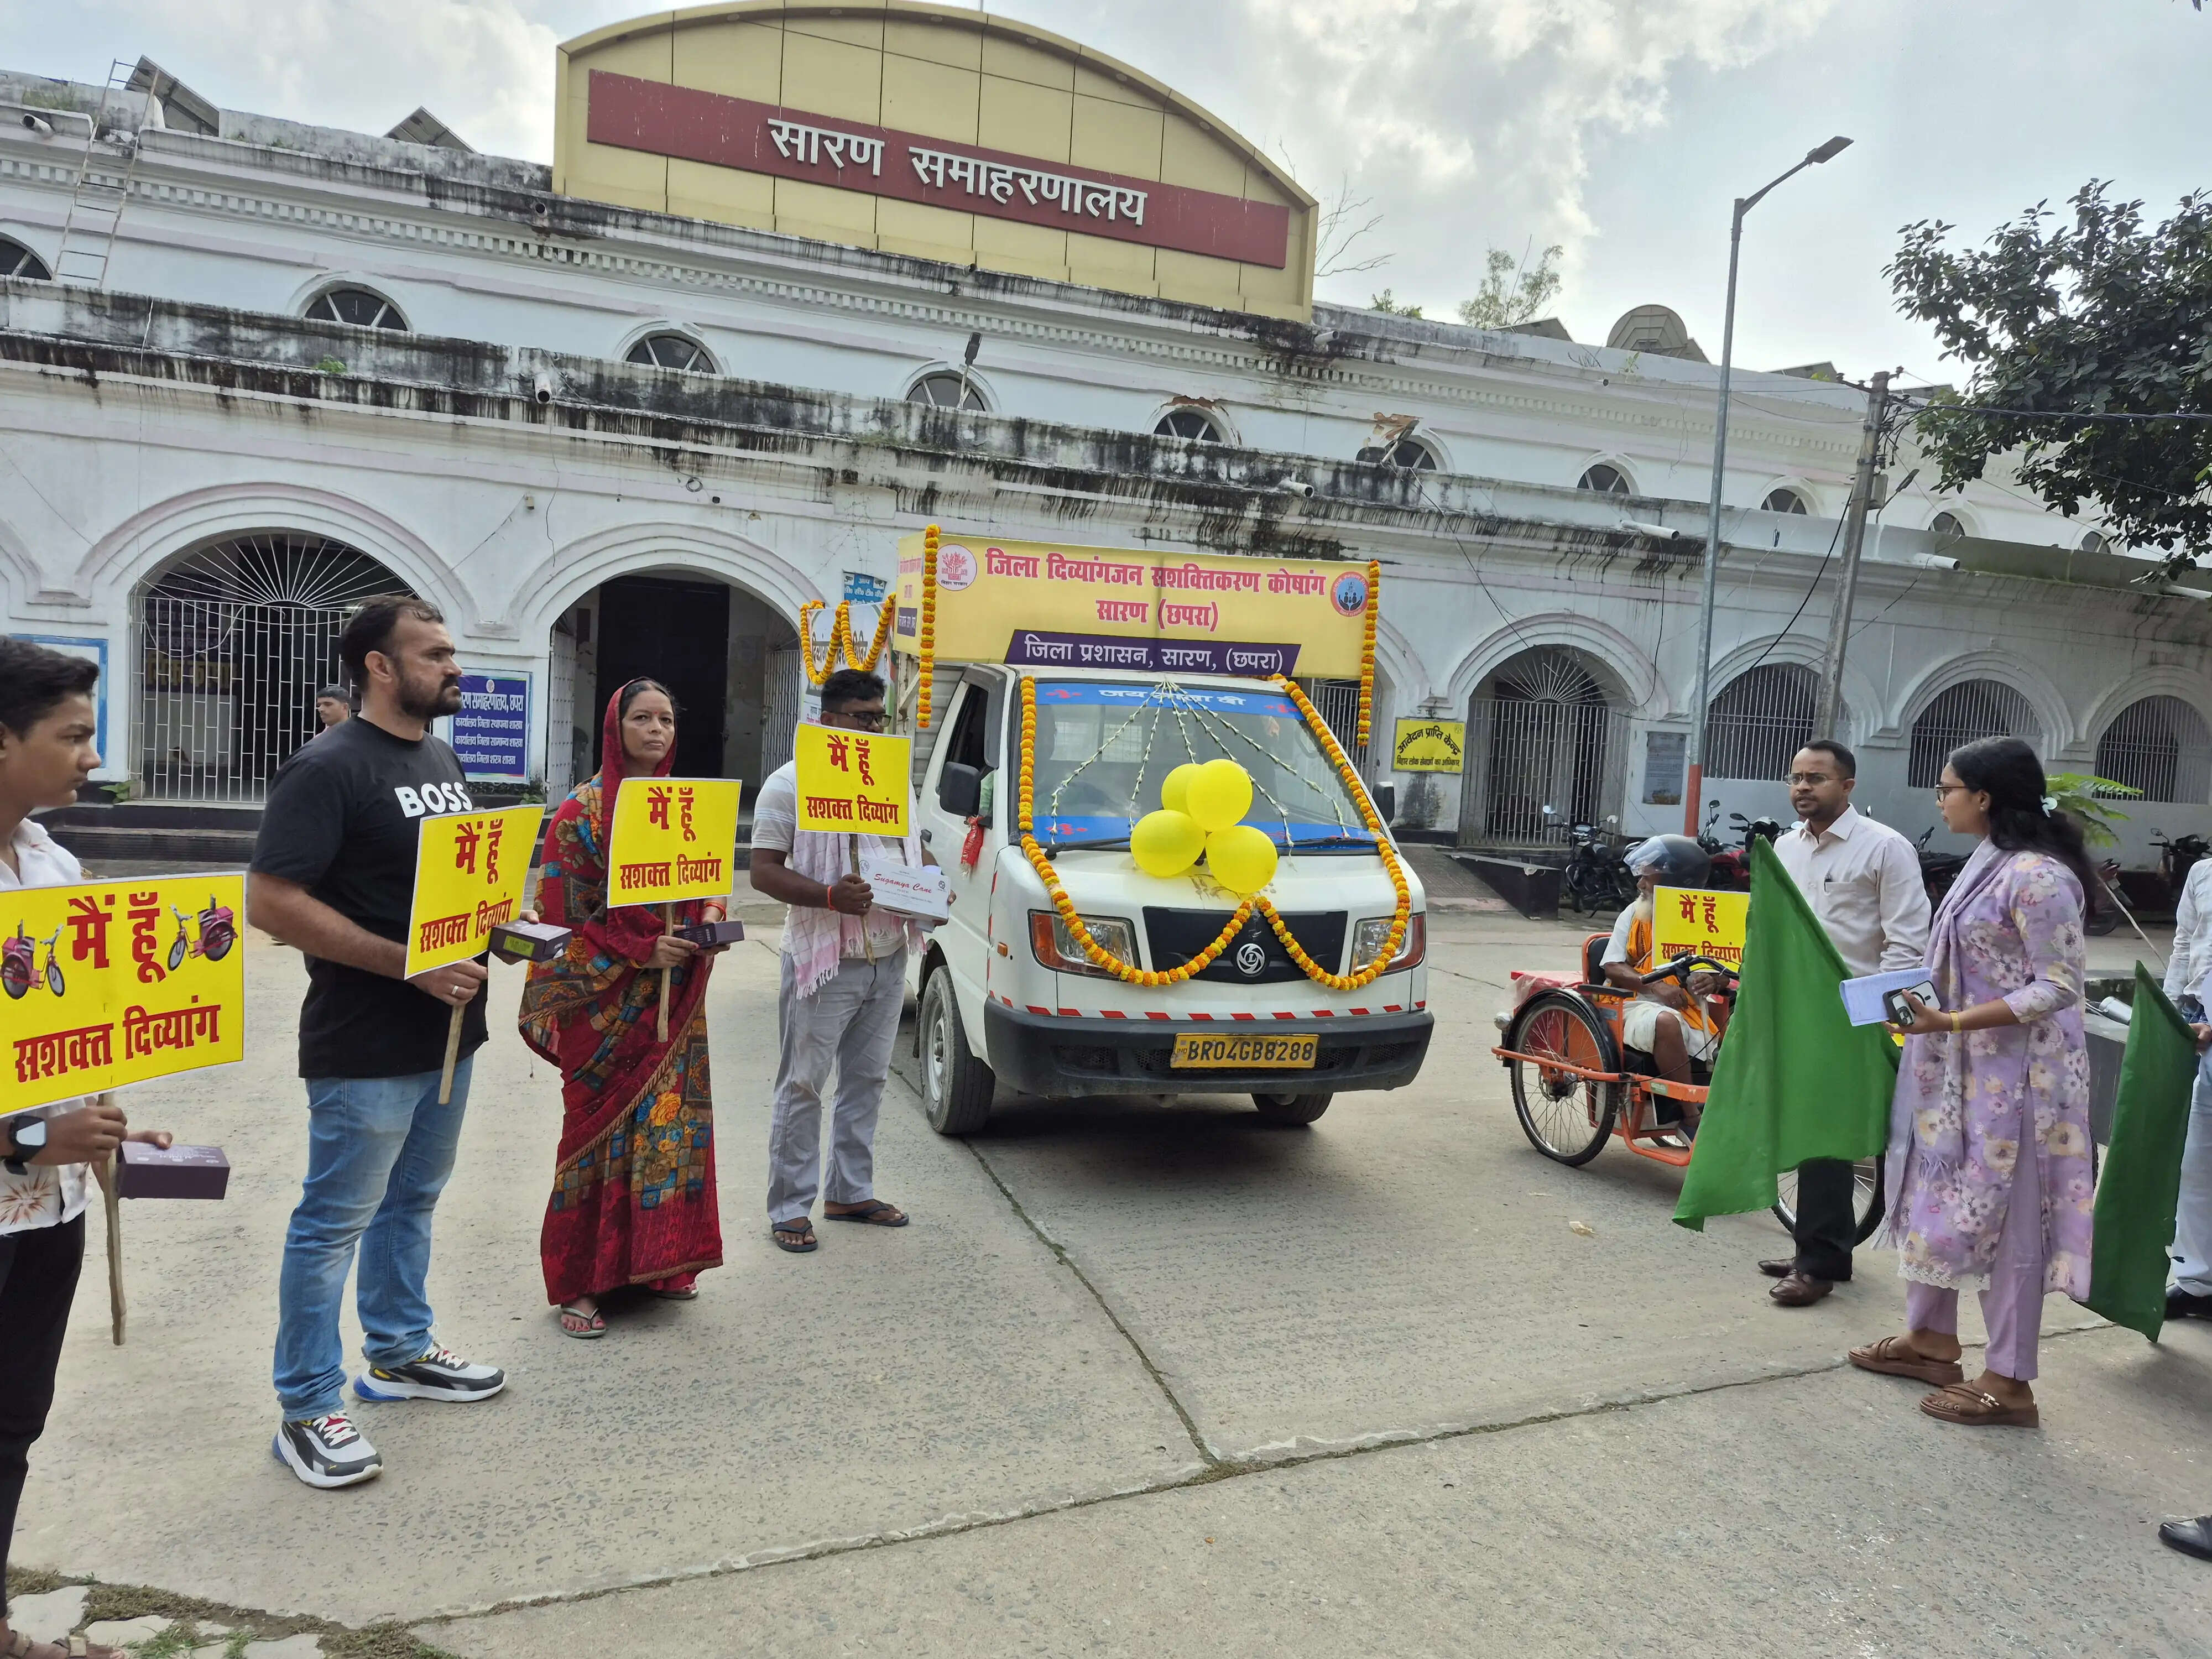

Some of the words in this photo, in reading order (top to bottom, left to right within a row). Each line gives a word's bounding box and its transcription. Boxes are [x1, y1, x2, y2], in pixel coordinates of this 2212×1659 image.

[768, 118, 885, 176] सारण
[909, 146, 1148, 226] समाहरणालय
[985, 547, 1040, 579] जिला
[1046, 552, 1144, 586] दिव्यांगजन
[1150, 562, 1261, 593] सशक्तिकरण
[1267, 568, 1327, 597] कोषांग
[1095, 599, 1149, 624] सारण
[1157, 598, 1218, 633] (छपरा)
[1024, 634, 1074, 660] जिला
[1079, 644, 1154, 669] प्रशासन,
[1161, 648, 1217, 671] सारण,
[1225, 648, 1283, 672] (छपरा)
[455, 714, 477, 727] कार्यालय
[477, 716, 490, 728] जिला
[491, 719, 509, 729] स्थापना
[509, 721, 523, 730] शाखा
[1397, 729, 1423, 754] आवेदन
[1425, 725, 1444, 740] प्राप्ति
[455, 733, 477, 745] कार्यालय
[477, 733, 490, 746] जिला
[490, 737, 509, 747] सामान्य
[509, 738, 523, 748] शाखा
[476, 751, 489, 764] जिला
[502, 755, 516, 765] शाखा
[827, 734, 850, 773] मैं
[855, 738, 875, 787] हूँ
[1396, 755, 1408, 766] बिहार
[1408, 756, 1420, 765] लोक
[394, 782, 473, 818] BOSS
[647, 786, 673, 830] मैं
[679, 787, 697, 842] हूँ
[806, 796, 853, 820] सशक्त
[857, 794, 899, 825] दिव्यांग
[455, 821, 483, 874] मैं
[487, 818, 504, 885] हूँ
[619, 862, 671, 889] सशक्त
[677, 852, 722, 885] दिव्यांग
[874, 873, 910, 889] Sugamya
[912, 883, 932, 894] Cane
[420, 912, 471, 953] सशक्त
[475, 891, 513, 939] दिव्यांग
[1679, 894, 1698, 924] मैं
[1703, 895, 1719, 933] हूँ
[66, 894, 116, 969] मैं
[127, 891, 166, 983] हूँ
[1701, 941, 1741, 963] दिव्यांग
[13, 1022, 114, 1083] सशक्त
[122, 994, 221, 1060] दिव्यांग
[1187, 1040, 1314, 1061] BR04GB8288
